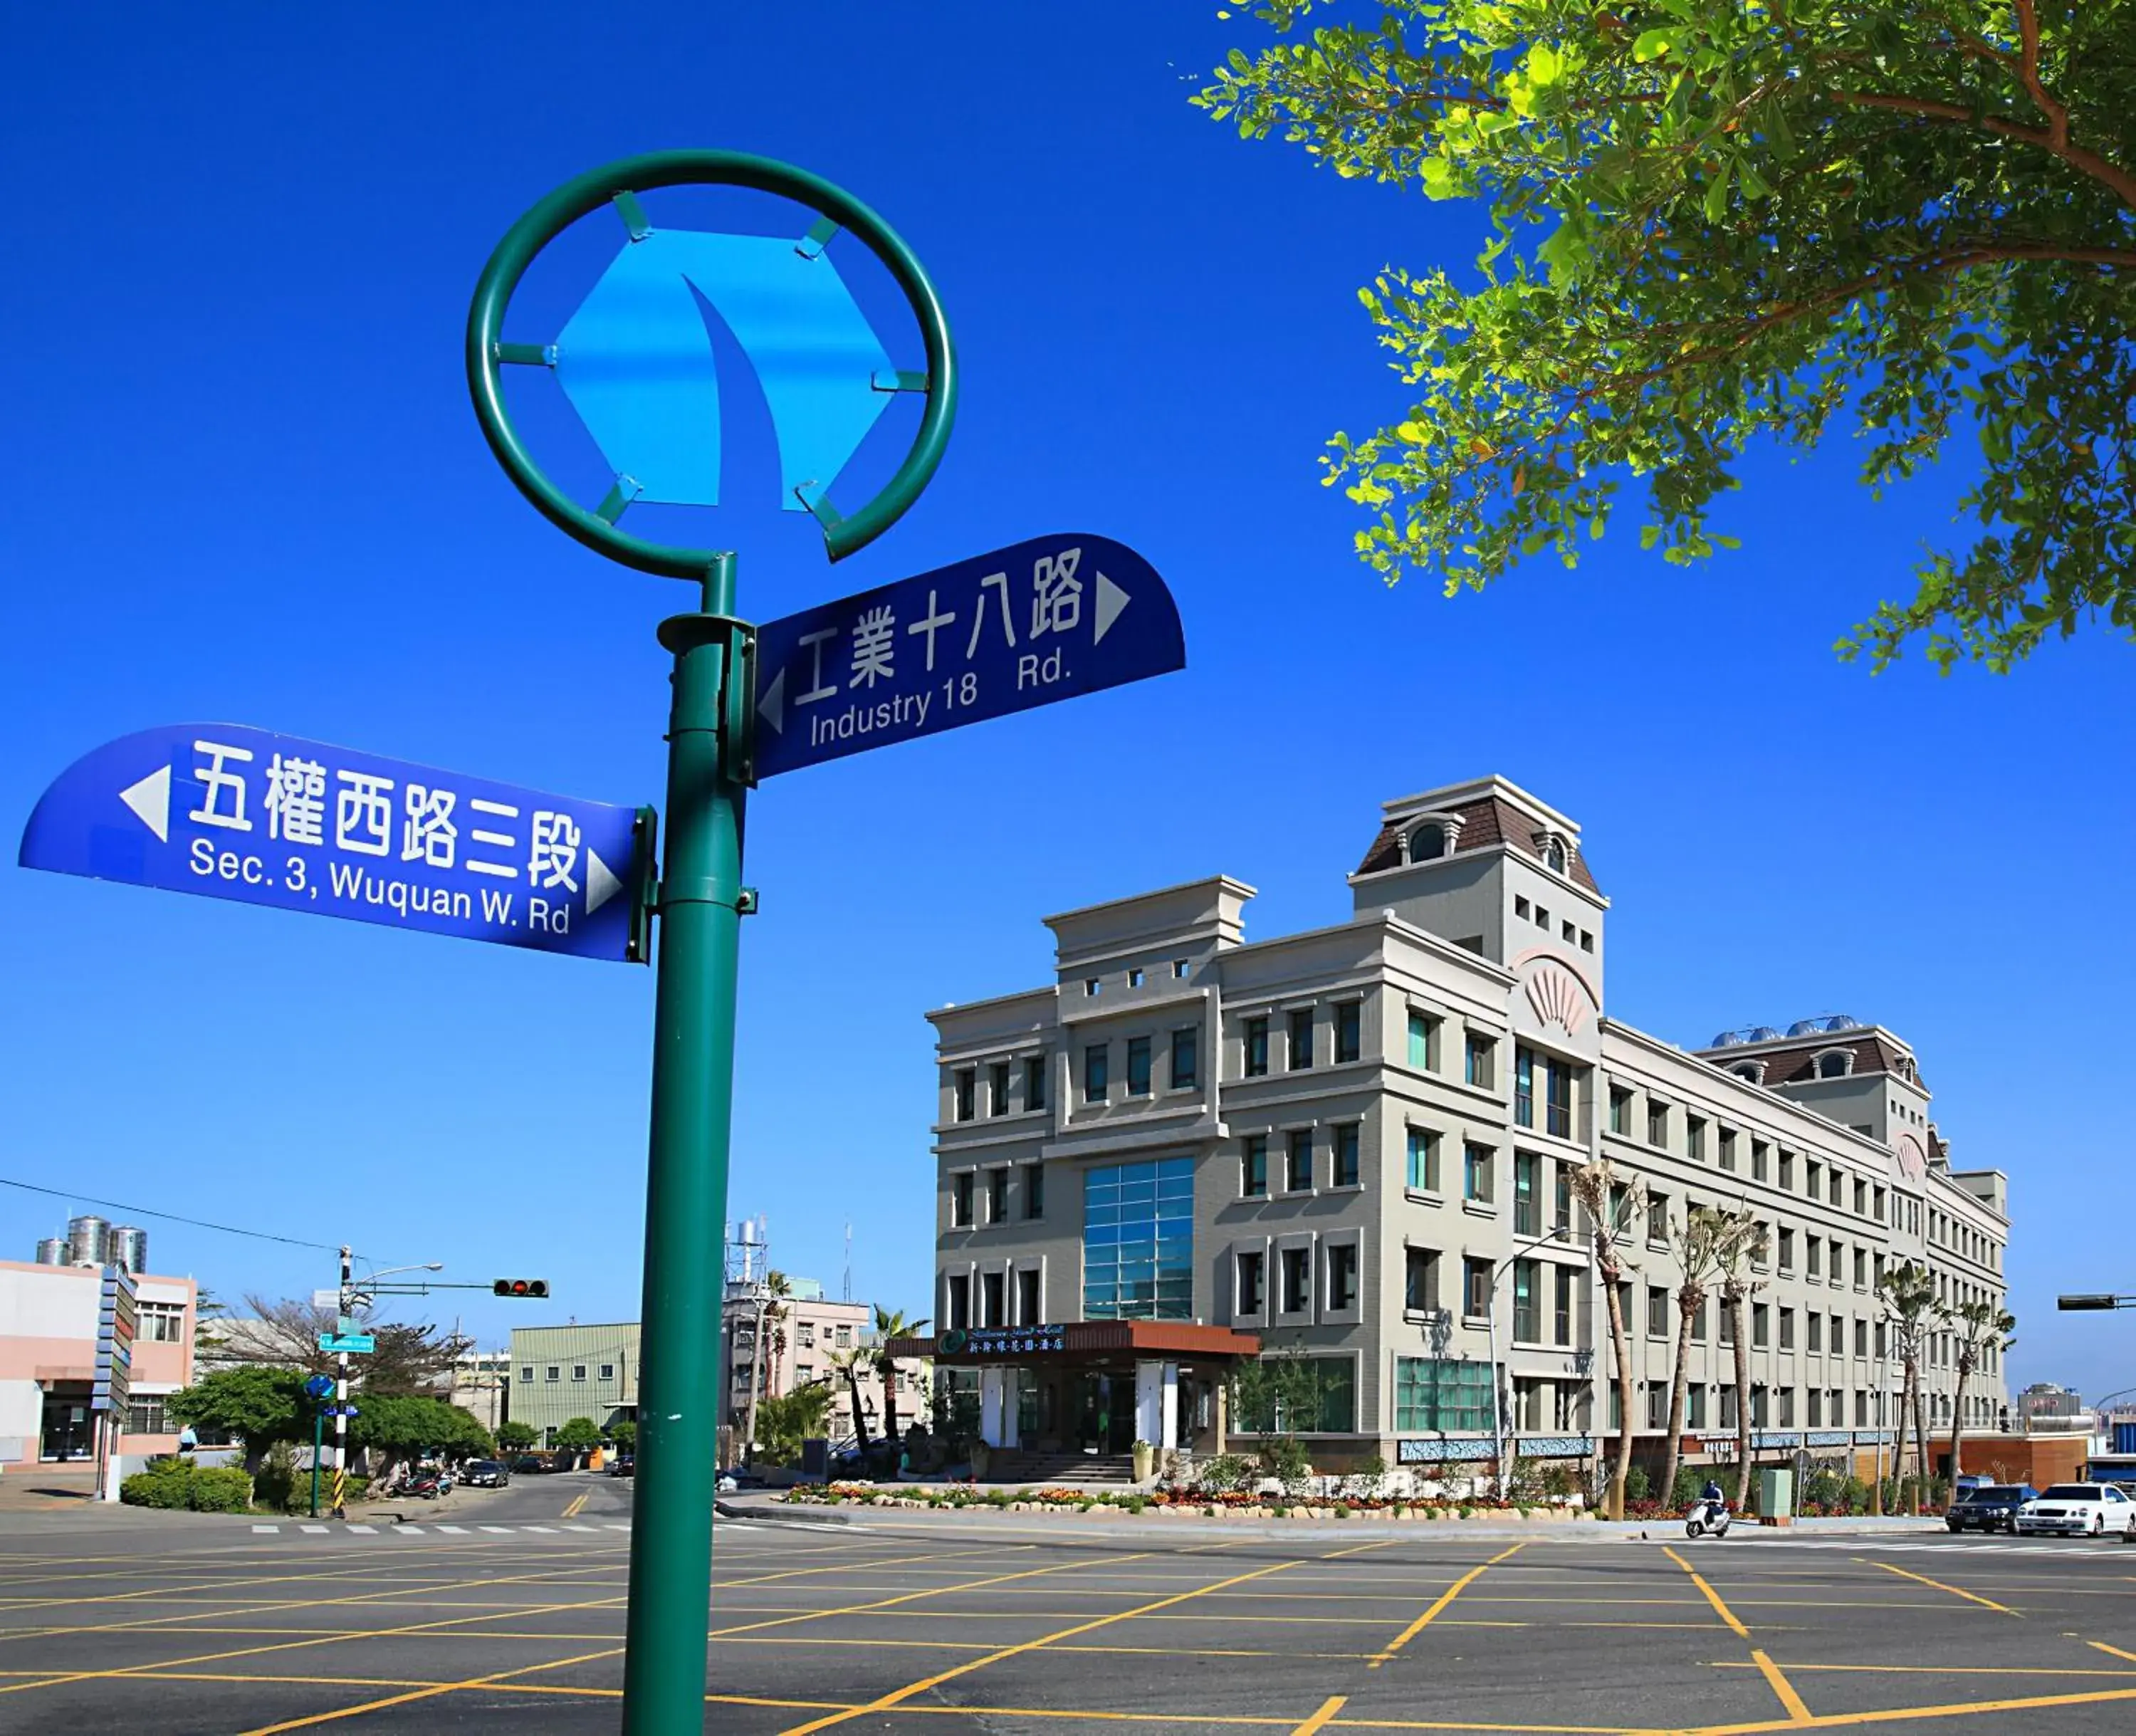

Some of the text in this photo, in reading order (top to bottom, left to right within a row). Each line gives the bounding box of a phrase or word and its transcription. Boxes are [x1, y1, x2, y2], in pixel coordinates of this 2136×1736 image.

[795, 548, 1083, 706] 工業十八路
[811, 647, 1071, 746] Industry 18 Rd.
[189, 740, 580, 893] 五權西路三段
[190, 838, 569, 934] Sec. 3, Wuquan W. Rd
